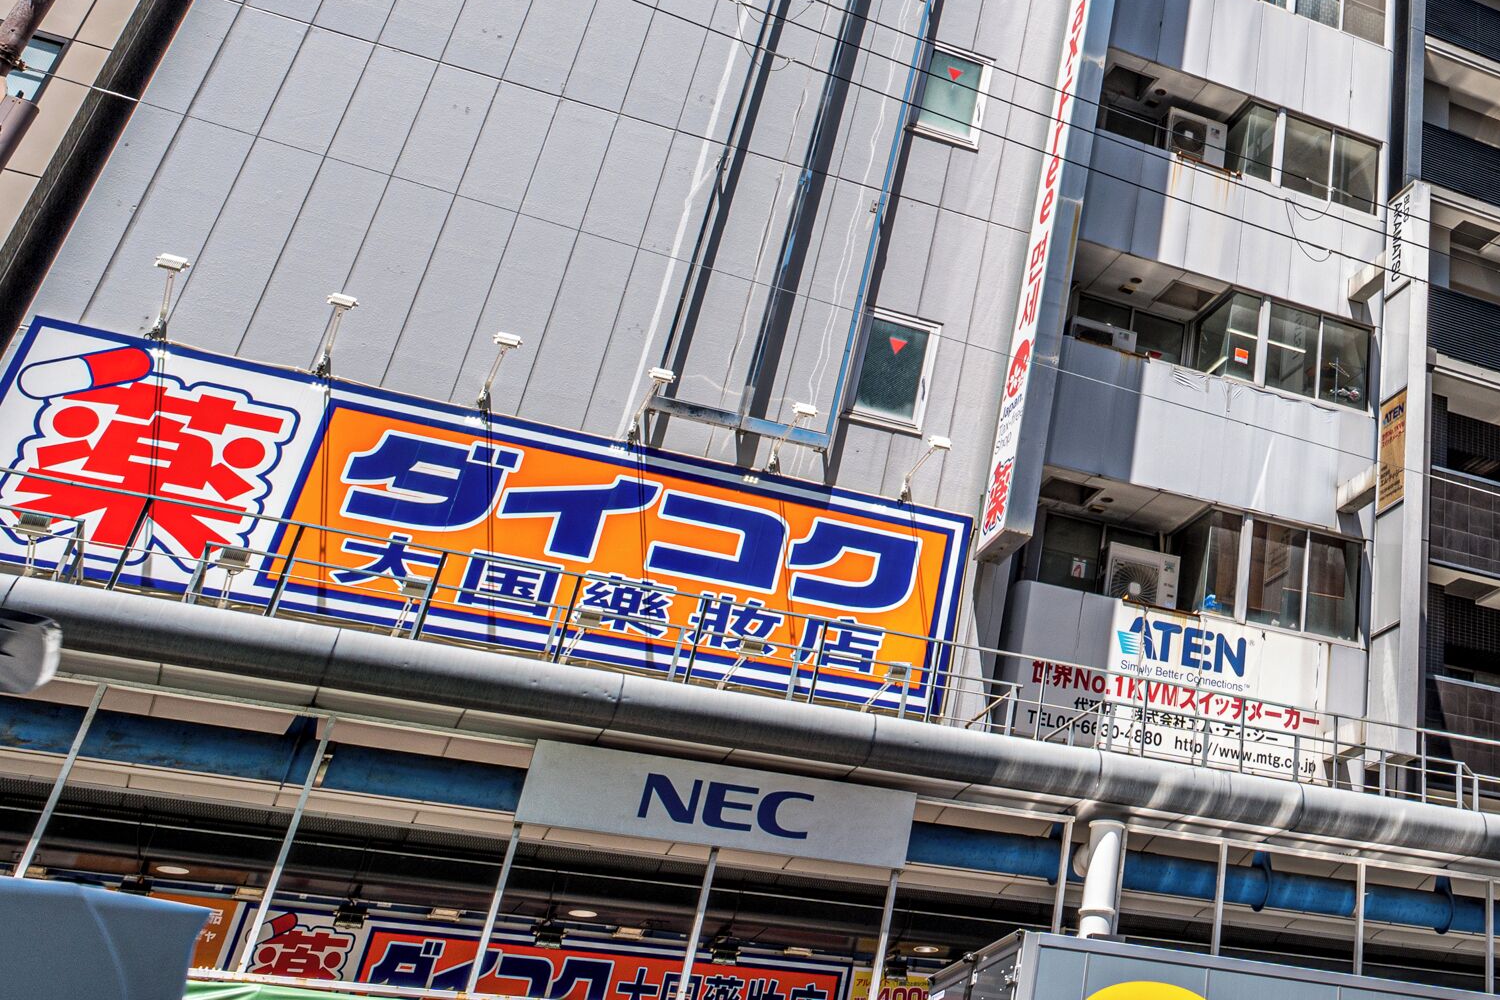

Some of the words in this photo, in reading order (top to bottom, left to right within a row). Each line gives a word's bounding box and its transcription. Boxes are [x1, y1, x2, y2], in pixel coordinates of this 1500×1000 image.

[1391, 202, 1403, 282] AKAMATSU
[1384, 402, 1405, 423] ATEN
[9, 380, 285, 560] 薬
[340, 429, 924, 614] ダイコク
[1127, 615, 1246, 678] ATEN
[1155, 666, 1184, 681] Better
[637, 773, 815, 840] NEC
